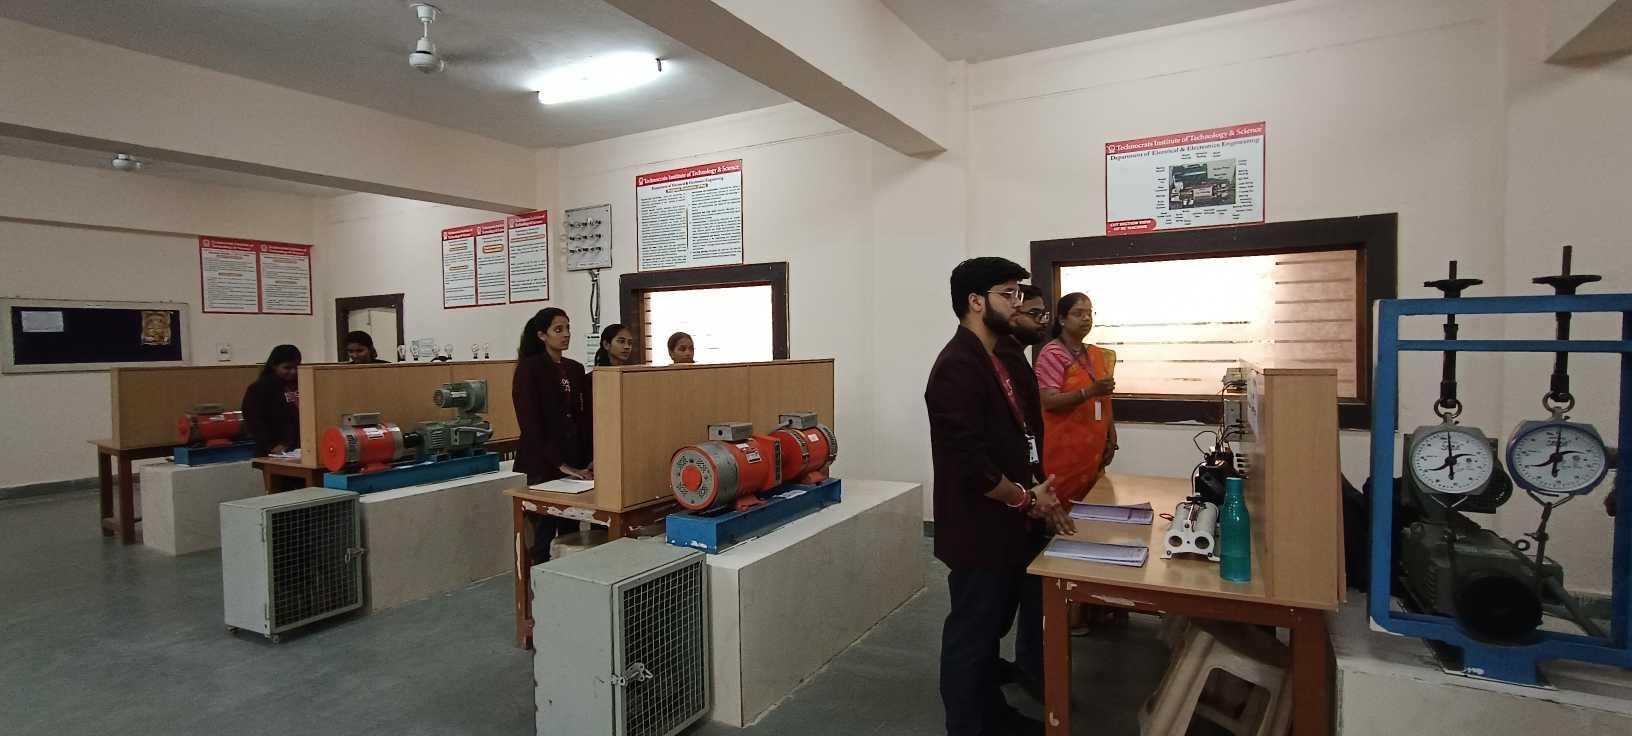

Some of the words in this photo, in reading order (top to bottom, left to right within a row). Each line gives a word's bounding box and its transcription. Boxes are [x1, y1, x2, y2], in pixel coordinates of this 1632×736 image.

[1116, 141, 1153, 151] Technocrats
[1154, 137, 1181, 146] Institute
[1189, 131, 1228, 141] Technology
[1236, 127, 1263, 136] Science
[691, 168, 717, 178] Technology
